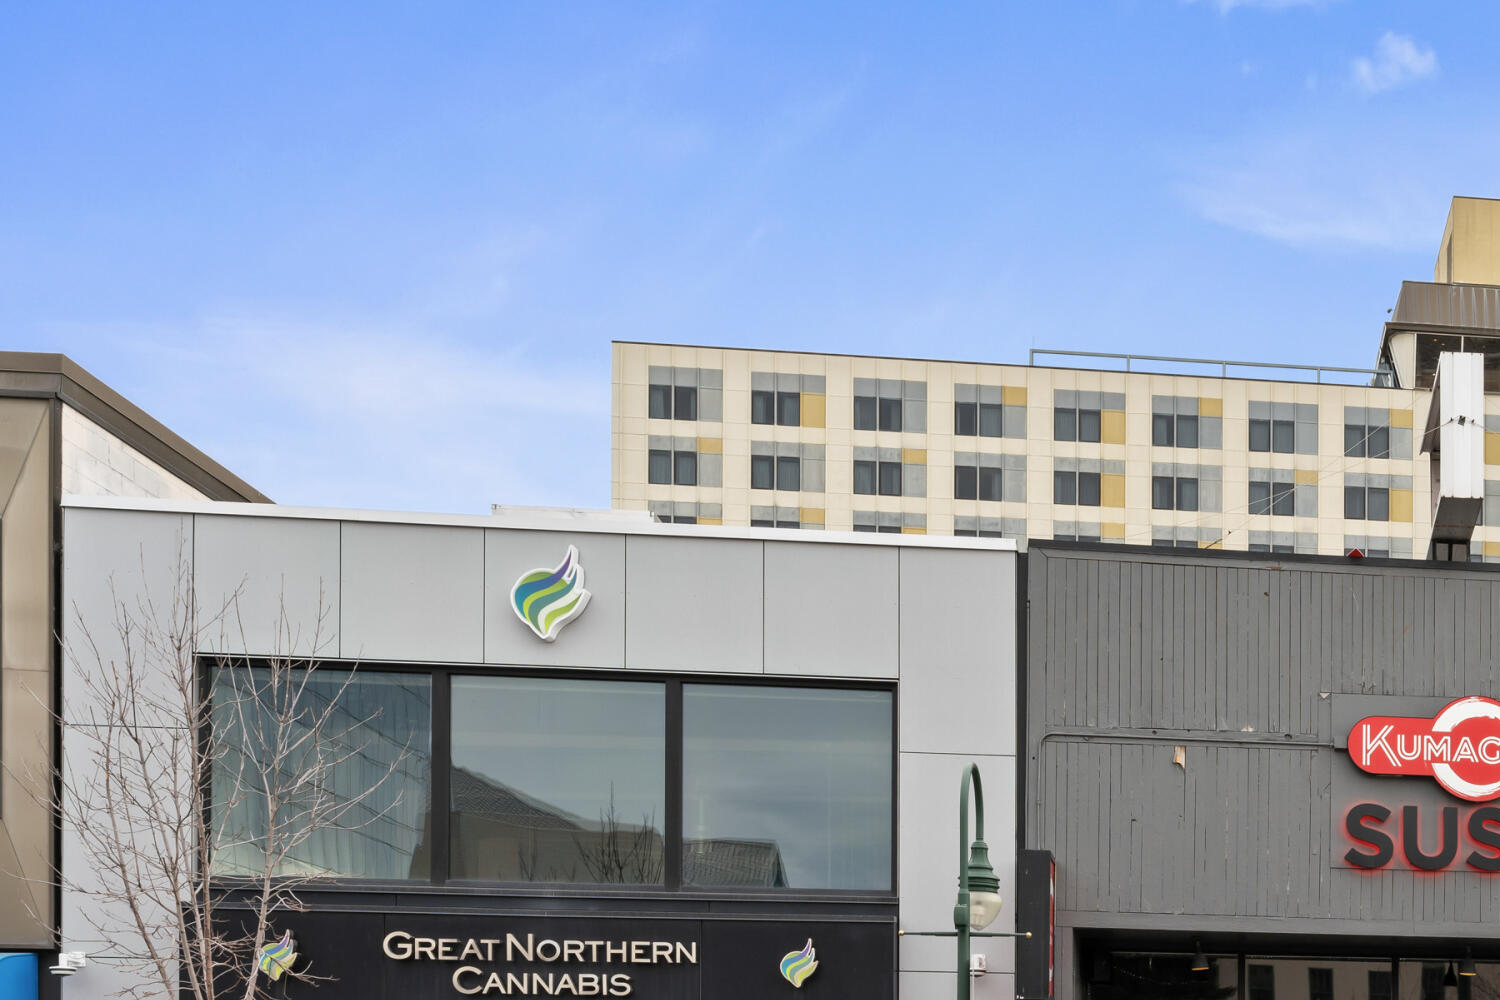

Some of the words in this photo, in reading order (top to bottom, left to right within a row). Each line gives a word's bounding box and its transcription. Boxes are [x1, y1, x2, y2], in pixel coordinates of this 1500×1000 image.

[382, 931, 501, 961] GREAT
[506, 933, 698, 964] NORTHERN
[452, 965, 632, 997] CANNABIS
